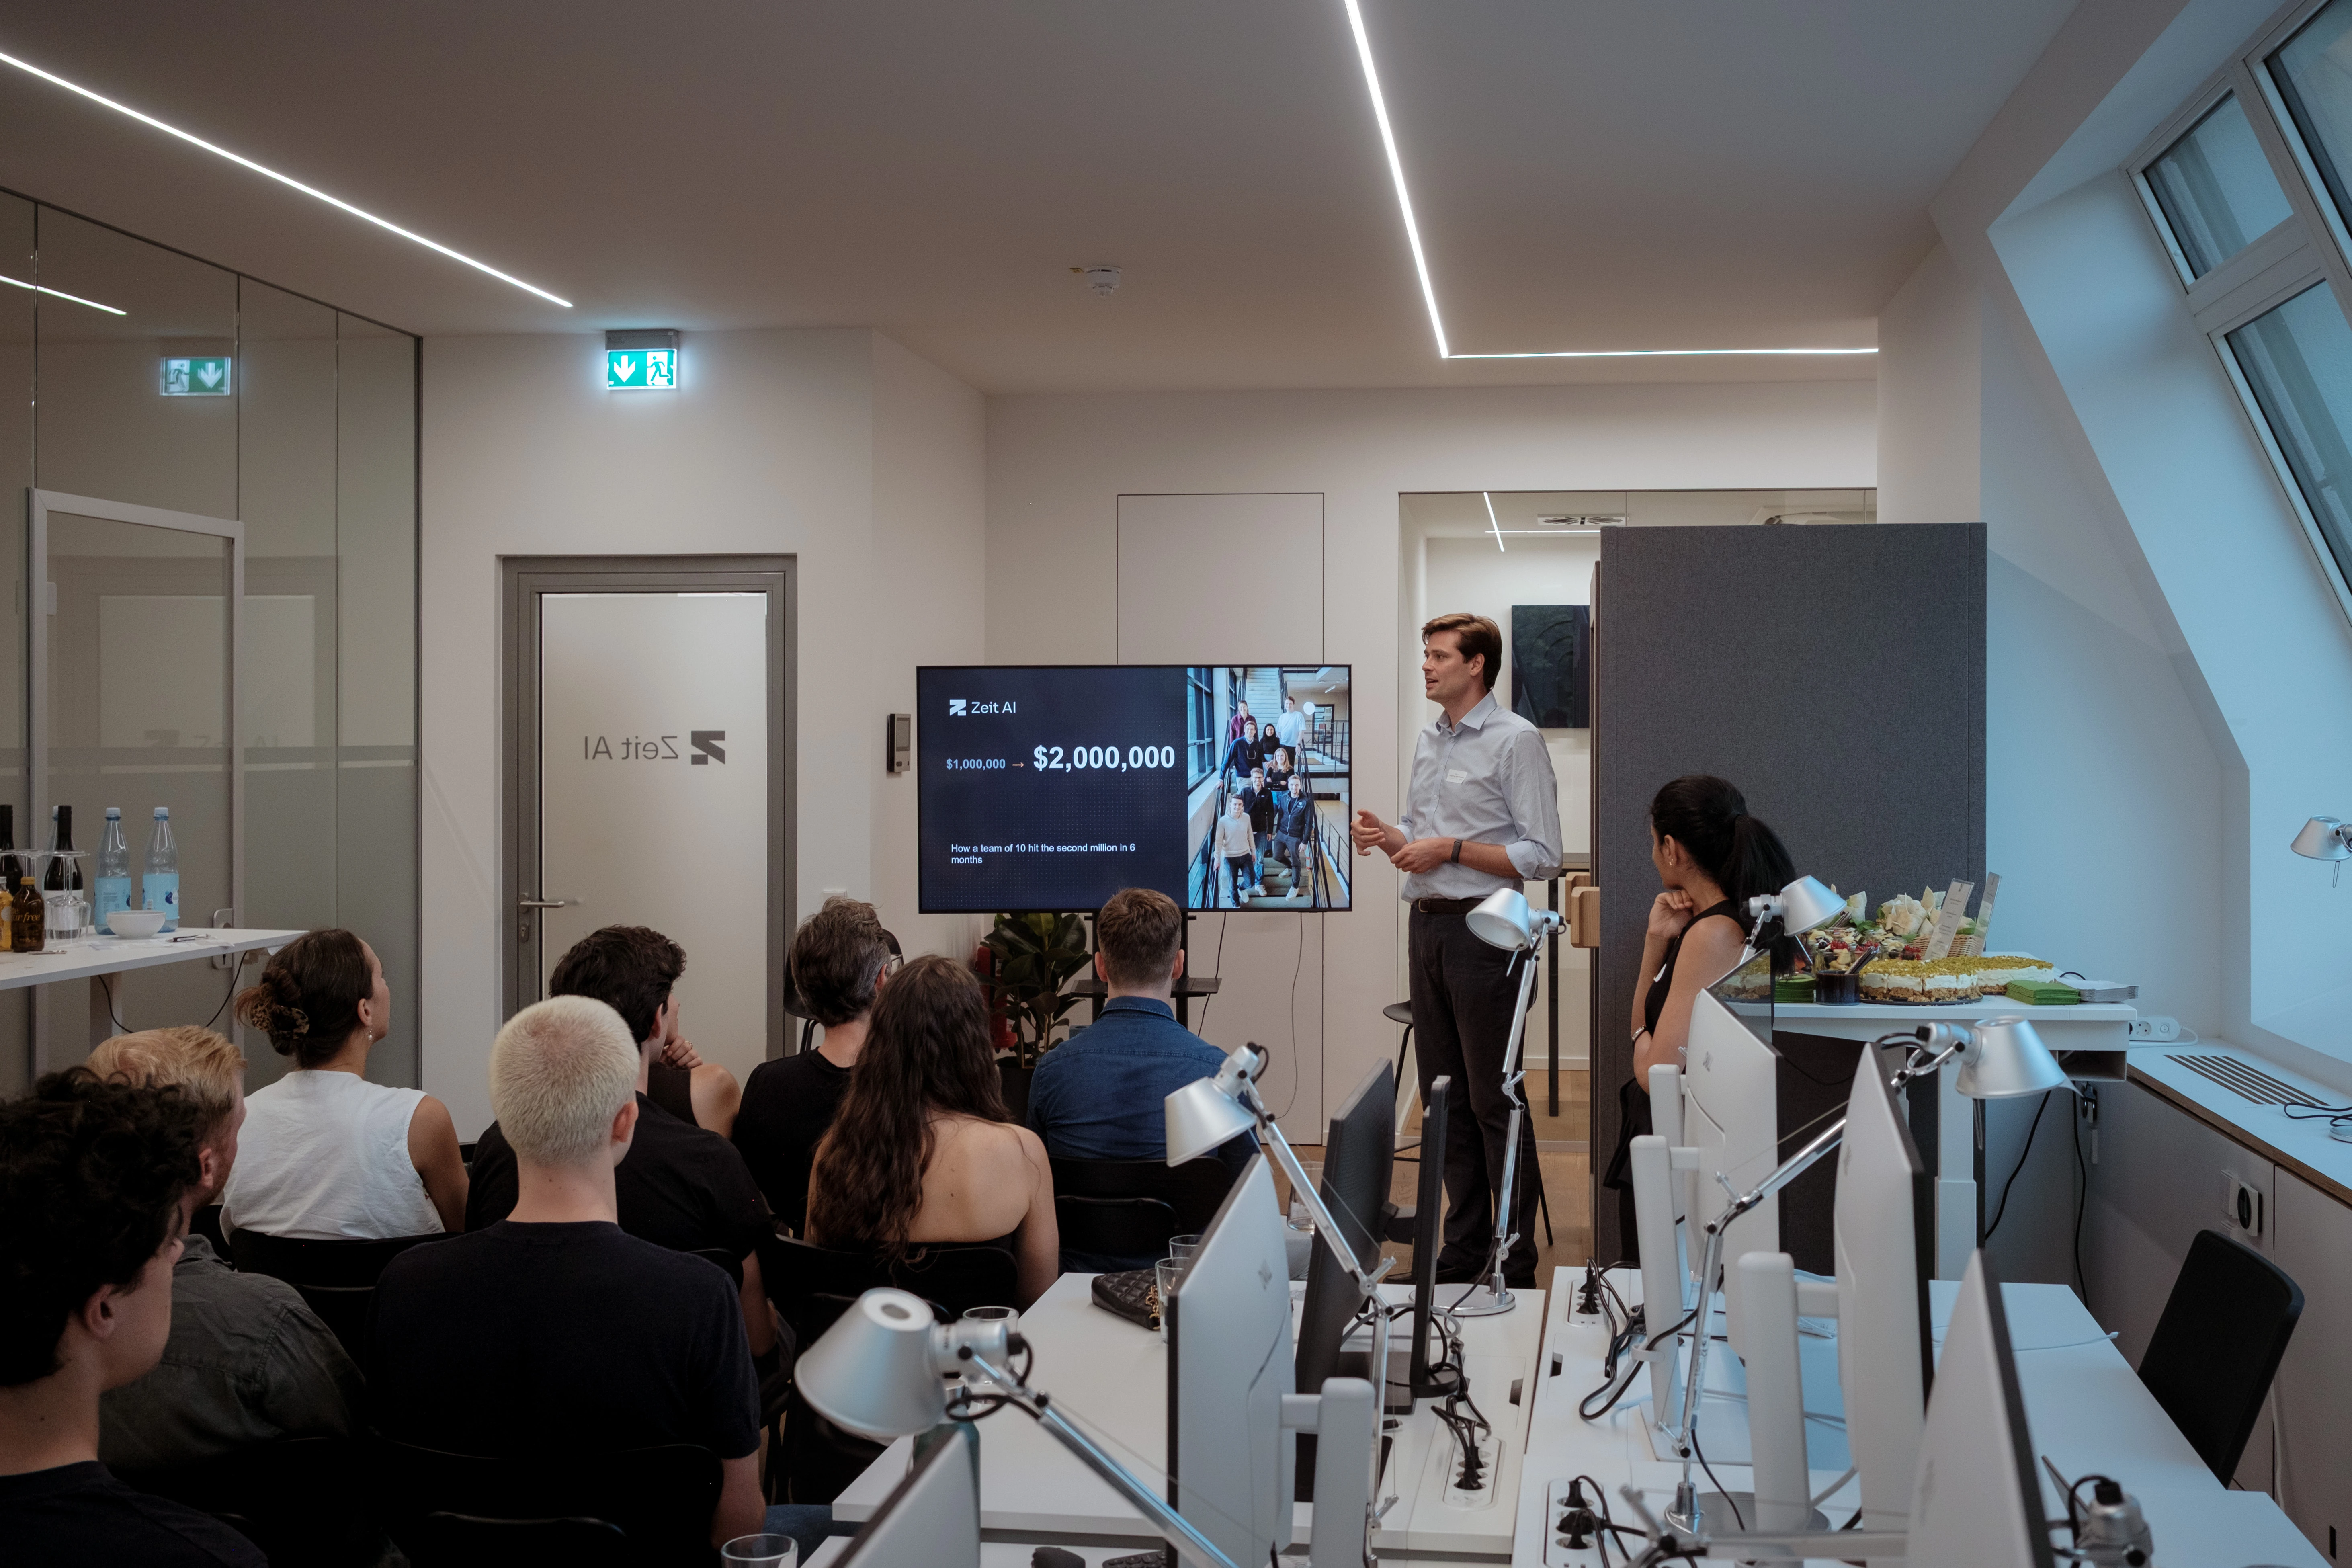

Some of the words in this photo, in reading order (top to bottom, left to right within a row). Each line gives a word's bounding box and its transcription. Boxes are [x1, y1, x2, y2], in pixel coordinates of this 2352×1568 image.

[971, 701, 999, 714] Zeit
[1002, 701, 1016, 714] AI
[946, 758, 1006, 771] $1,000,000
[1033, 745, 1175, 773] $2,000,000
[951, 844, 971, 853] How
[980, 844, 1002, 852] team
[1004, 844, 1013, 852] of
[1016, 844, 1026, 852] 10
[1028, 844, 1039, 852] hit
[1041, 843, 1055, 852] the
[1057, 843, 1088, 852] second
[1090, 843, 1117, 852] million
[1120, 843, 1127, 851] in
[1130, 843, 1135, 851] 6
[951, 855, 983, 864] months
[23, 912, 40, 923] free
